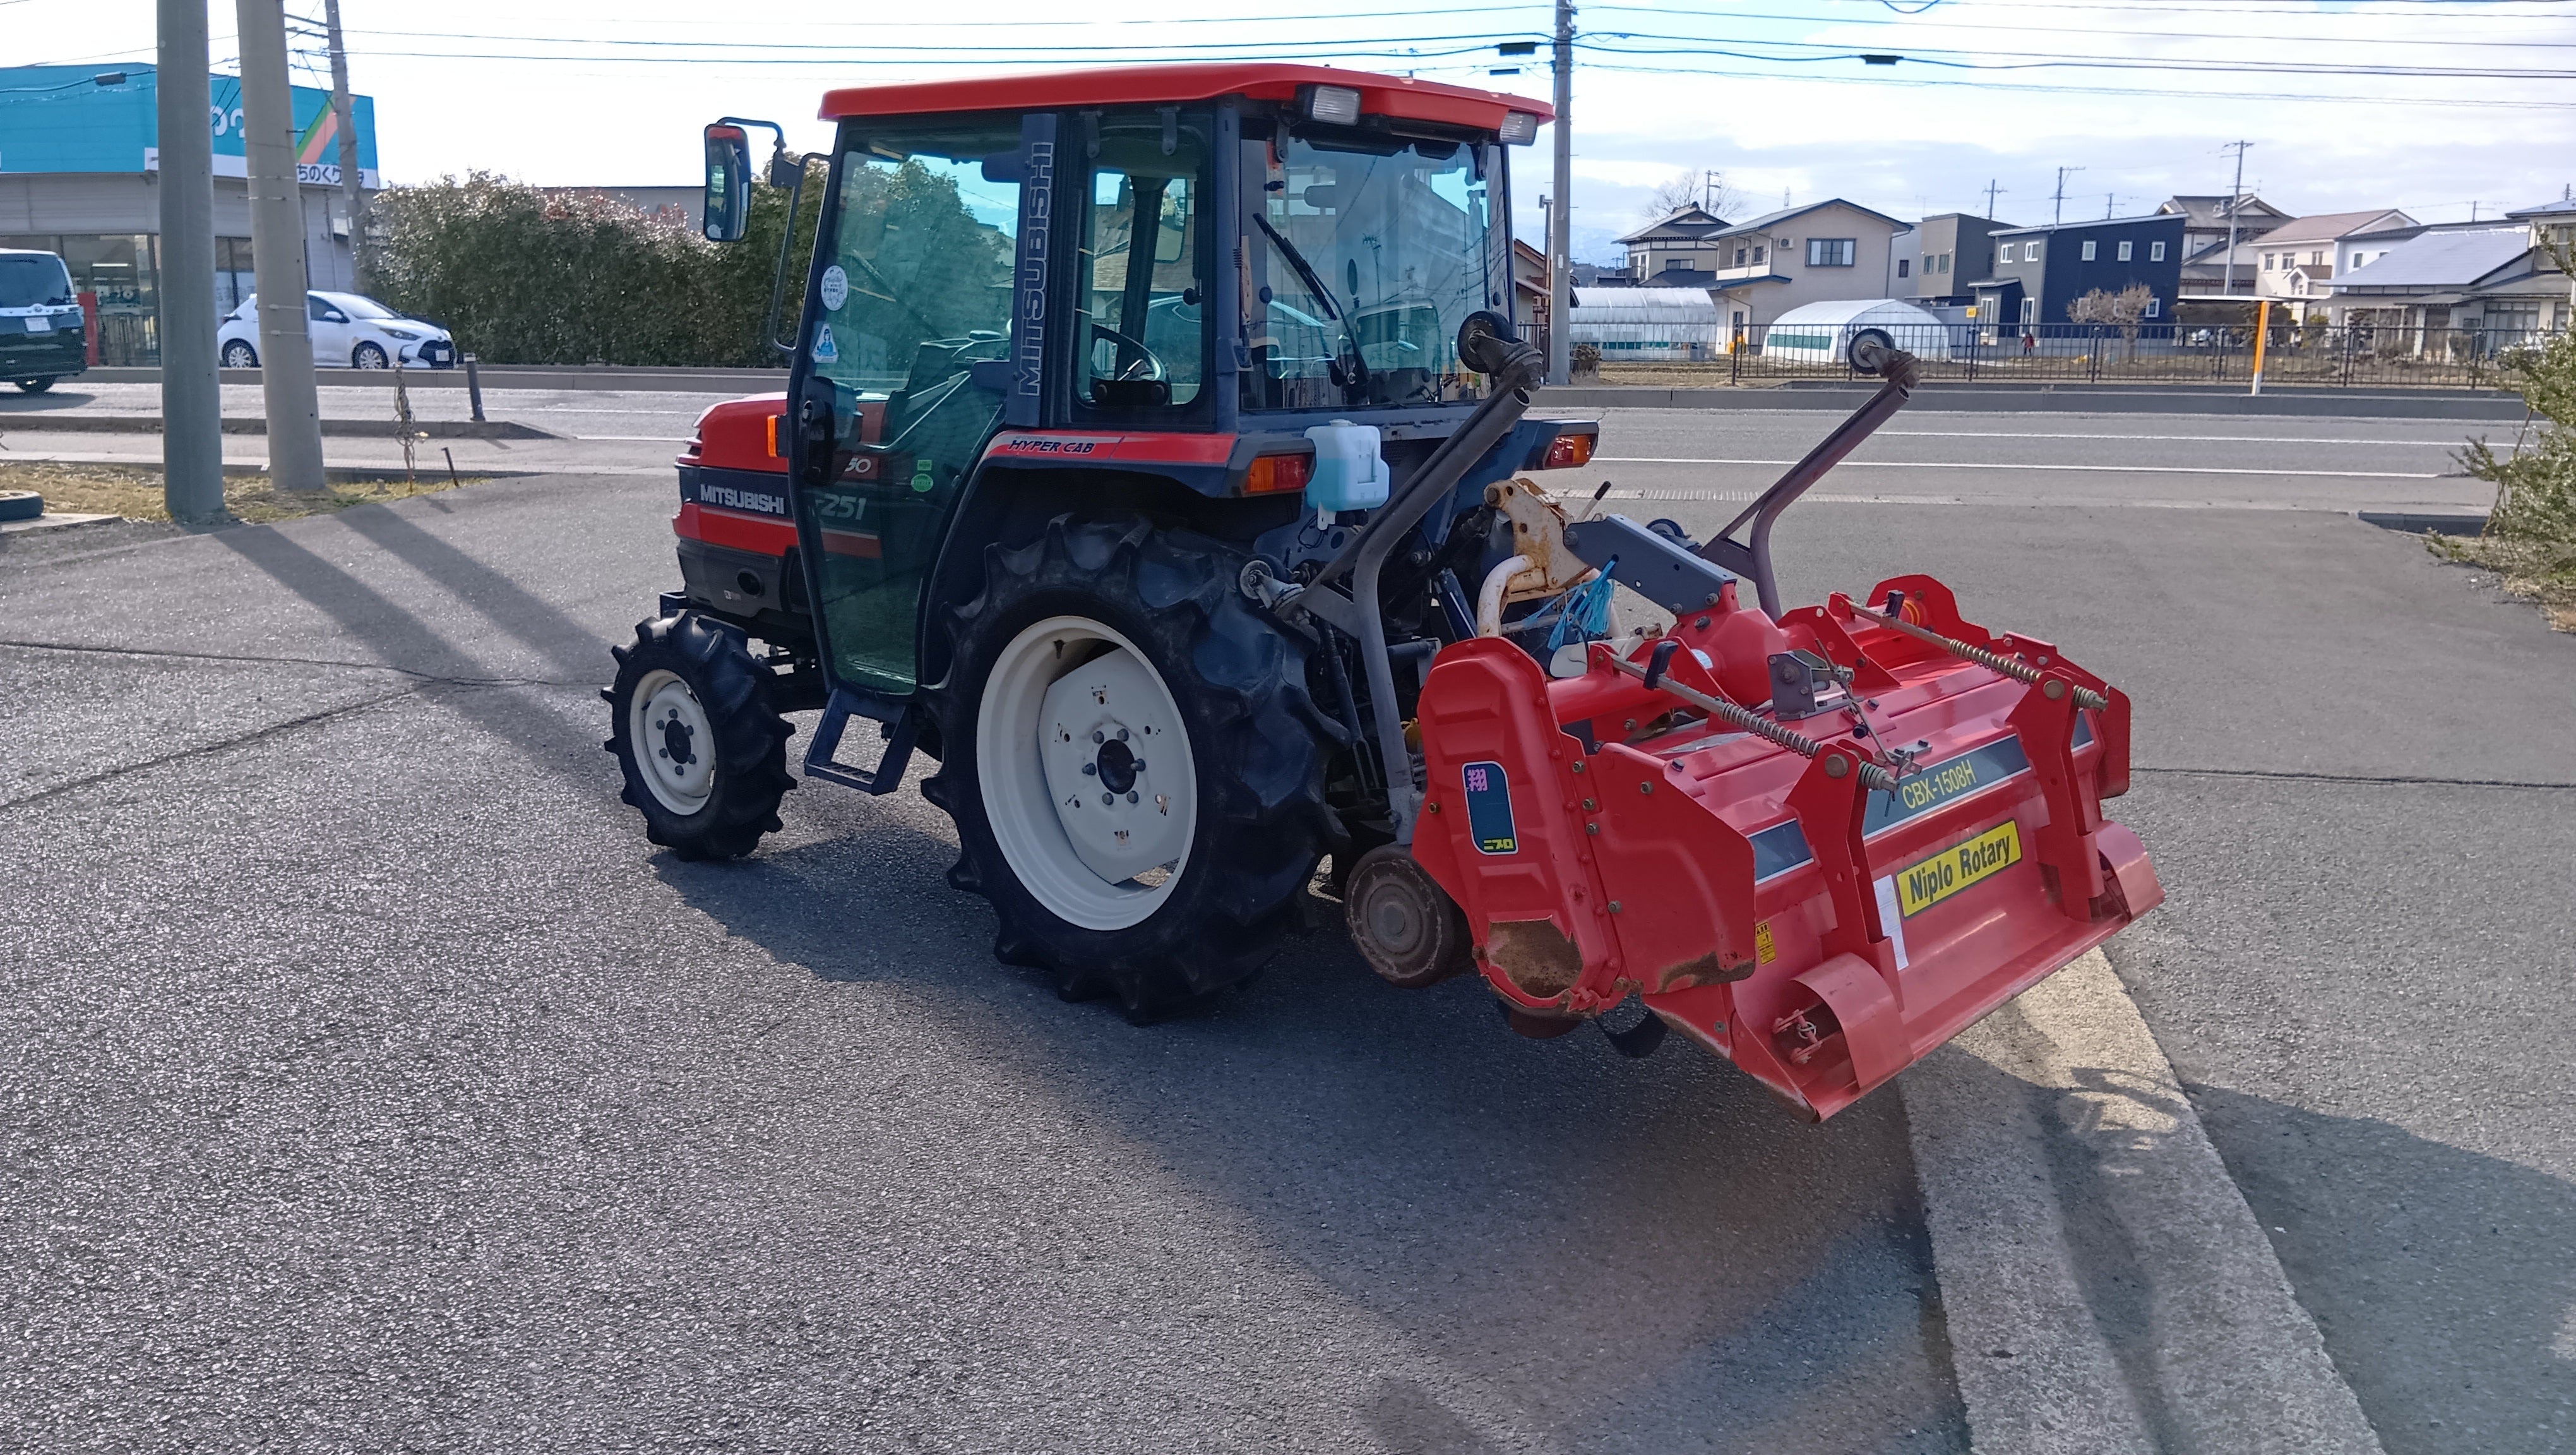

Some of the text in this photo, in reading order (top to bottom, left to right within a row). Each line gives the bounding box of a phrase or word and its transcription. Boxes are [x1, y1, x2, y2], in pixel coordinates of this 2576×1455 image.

[1018, 142, 1054, 397] MITSUBISHI
[1008, 440, 1095, 453] HYPER CAB
[700, 484, 785, 515] MITSUBISHI
[1467, 769, 1488, 792] 翔
[1902, 759, 1977, 809] CBX-1508H
[1909, 835, 2010, 904] Niplo Rotary
